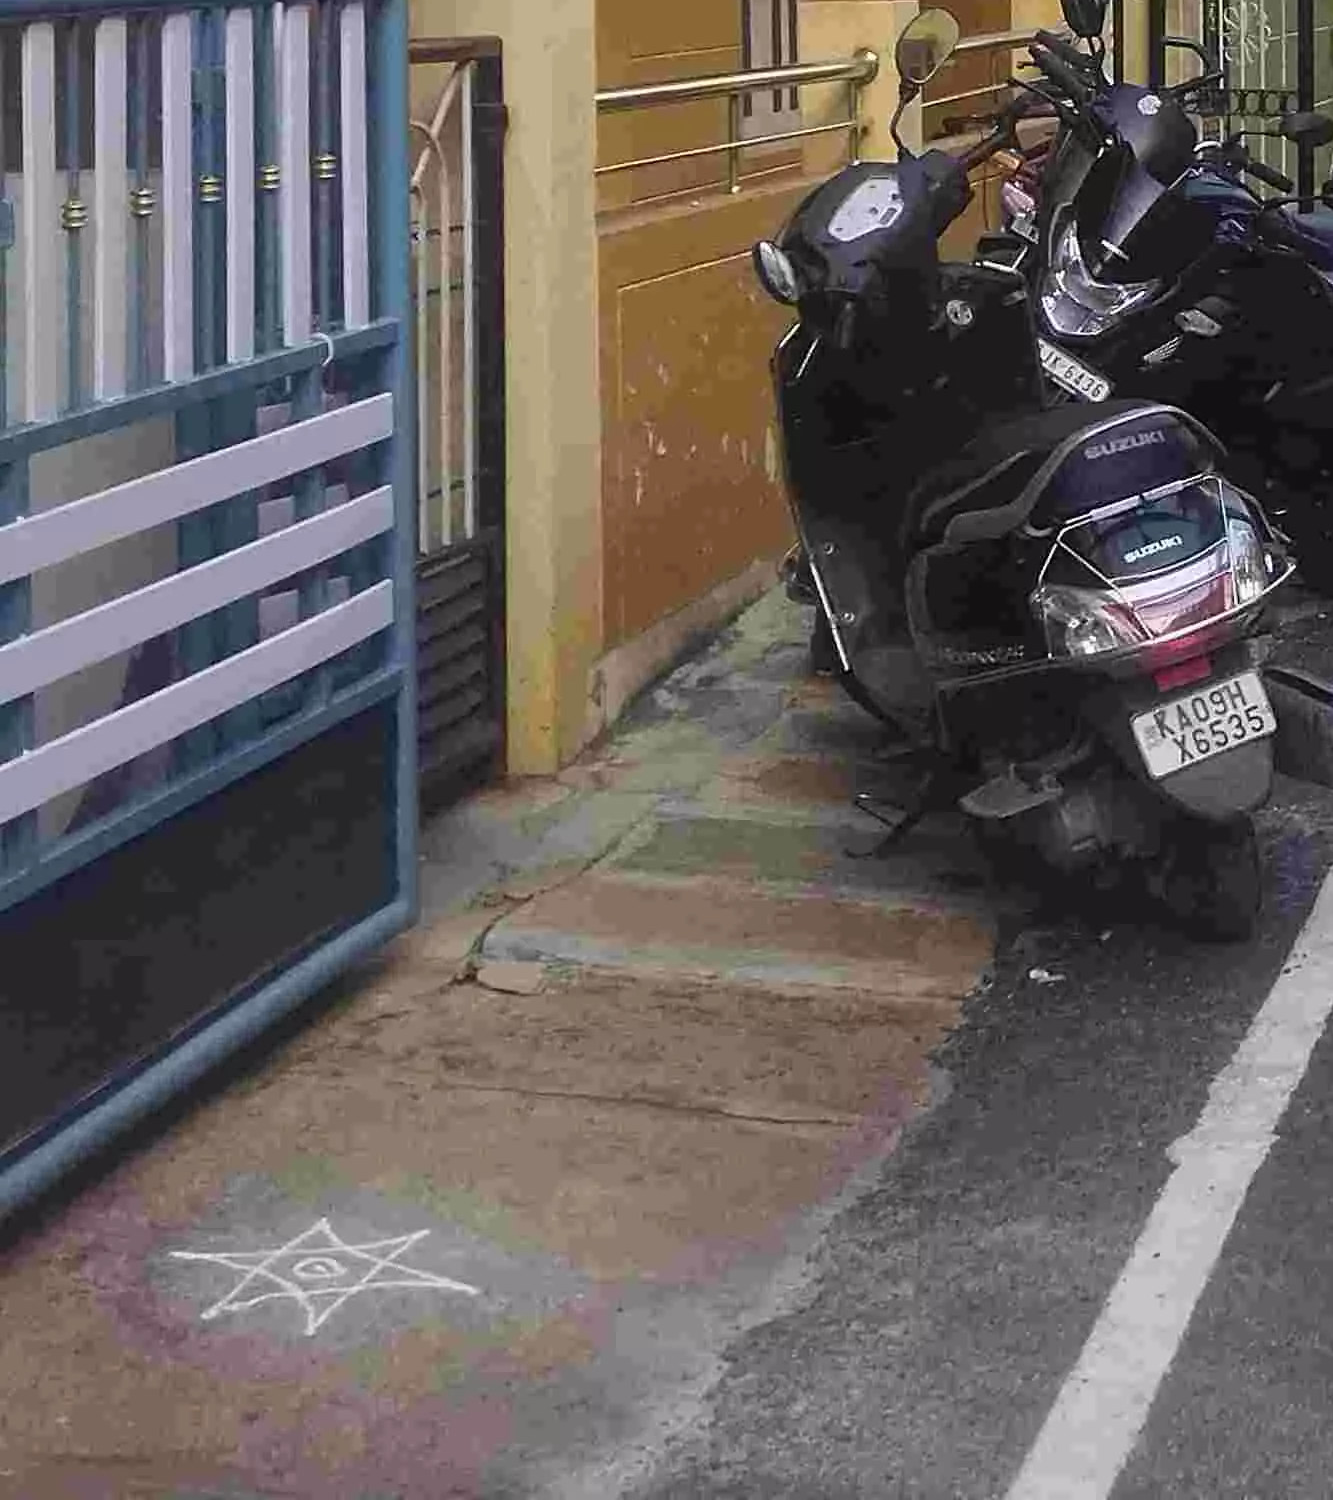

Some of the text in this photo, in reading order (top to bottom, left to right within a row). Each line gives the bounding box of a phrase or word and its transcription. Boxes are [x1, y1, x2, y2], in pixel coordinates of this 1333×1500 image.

[1083, 429, 1167, 460] SUZUKI
[1122, 534, 1184, 564] SUZUKI
[1153, 680, 1248, 739] KA09H
[1173, 704, 1265, 763] X6535
